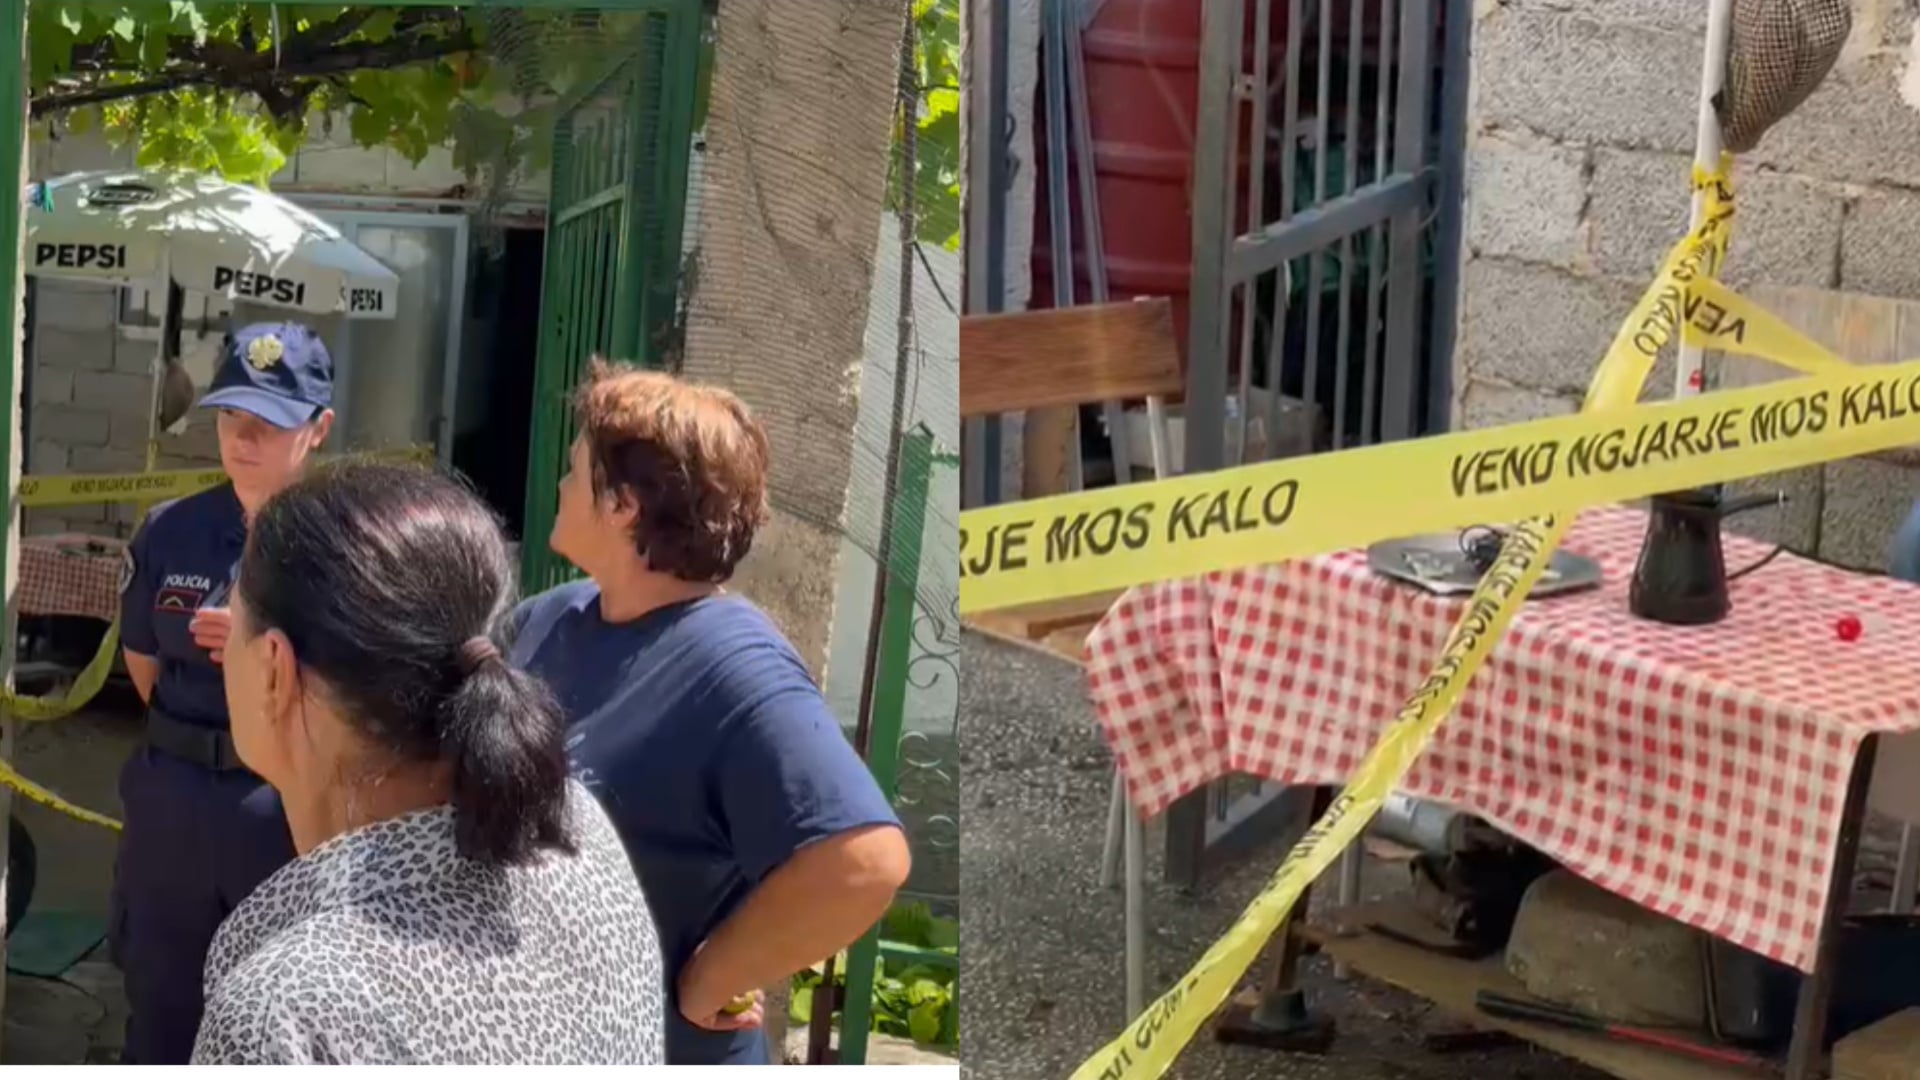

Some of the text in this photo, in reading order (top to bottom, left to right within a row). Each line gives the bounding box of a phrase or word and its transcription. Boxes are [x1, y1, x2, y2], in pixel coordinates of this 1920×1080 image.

[36, 243, 125, 268] PEPSI
[213, 266, 307, 305] PEPSI
[351, 288, 383, 312] PEPSI
[1452, 440, 1560, 498] VEND
[1567, 408, 1744, 478] NGJARJE
[1750, 390, 1829, 448] MOS
[1045, 502, 1155, 563] MOS
[1167, 479, 1299, 543] KALO
[163, 573, 211, 592] POLICIA
